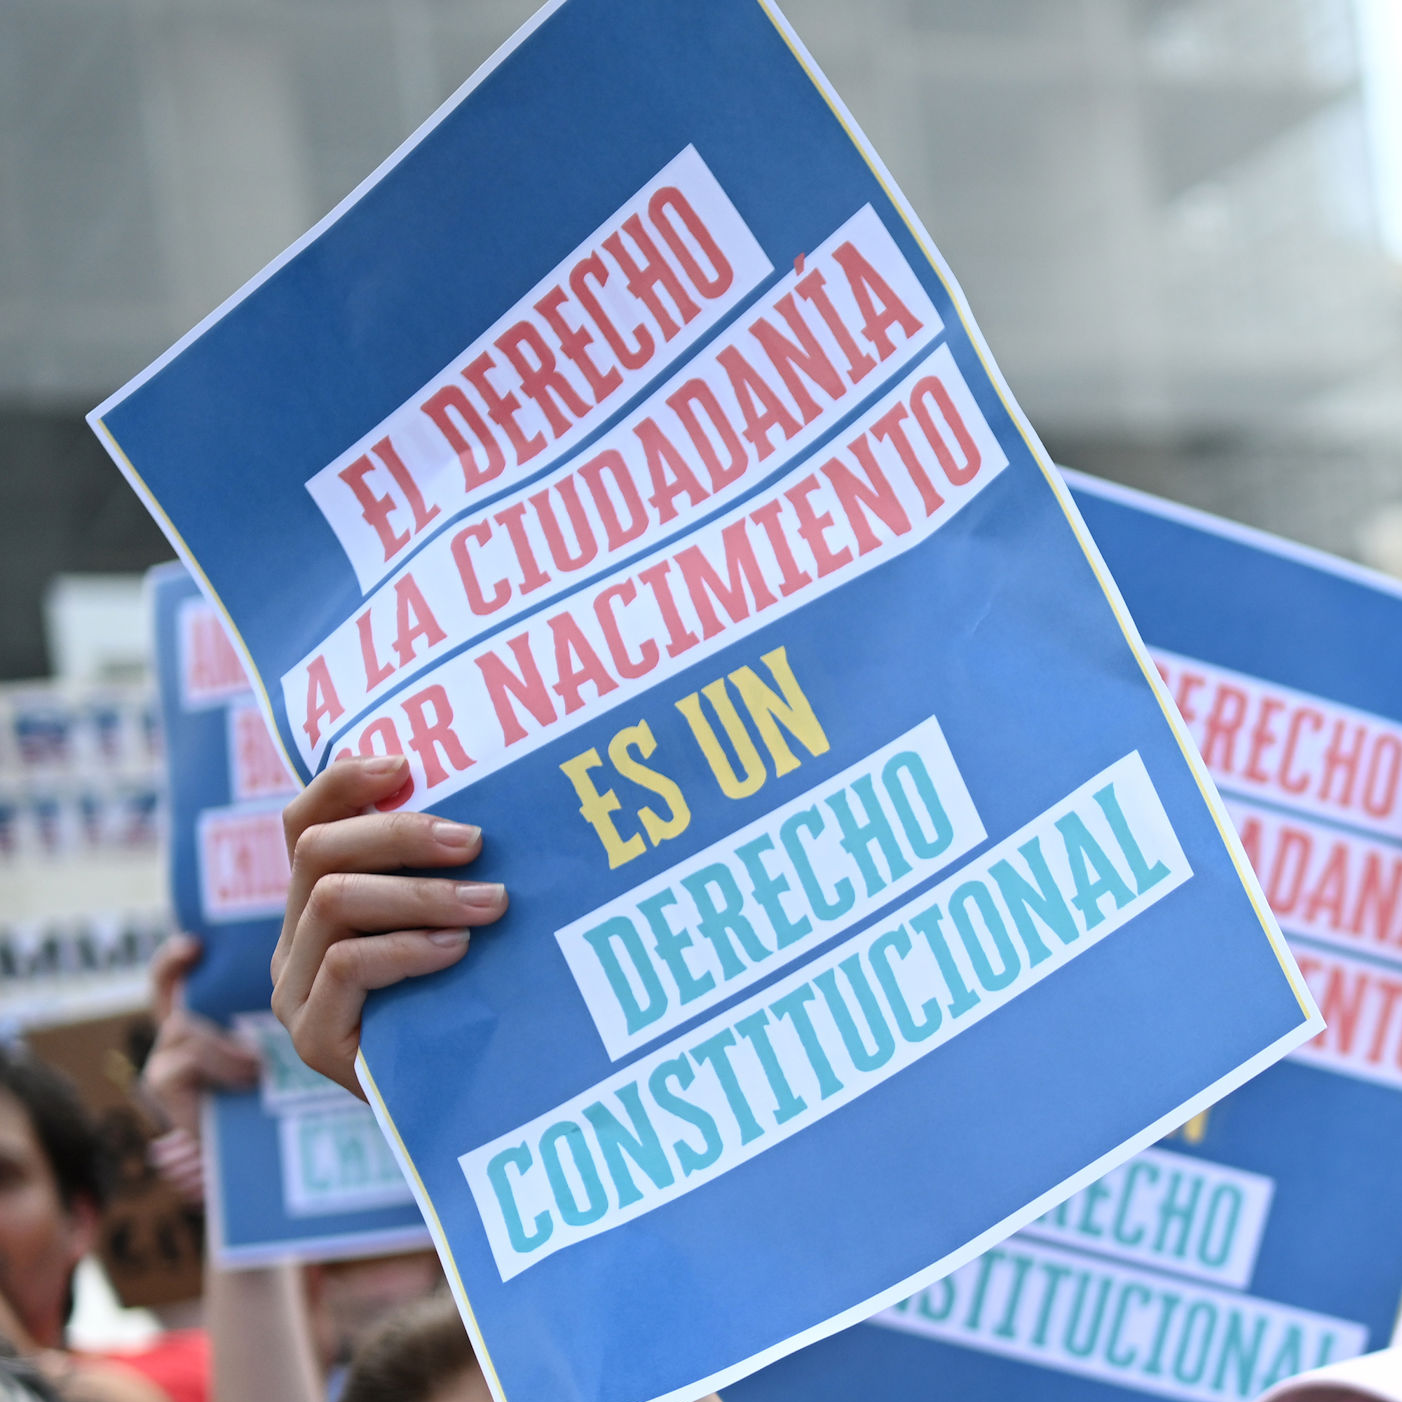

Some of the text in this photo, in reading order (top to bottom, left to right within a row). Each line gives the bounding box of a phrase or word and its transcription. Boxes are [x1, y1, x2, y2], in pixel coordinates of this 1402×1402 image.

[302, 655, 344, 750] A
[356, 572, 447, 692] LA
[450, 241, 923, 617] CIUDADANÍA
[338, 186, 733, 562] EL DERECHO
[334, 375, 982, 811] OR NACIMIENTO
[561, 645, 830, 870] ES UN
[484, 783, 1170, 1253] CONSTITUCIONAL
[585, 748, 955, 1036] DERECHO
[1032, 1159, 1244, 1268] ECHO
